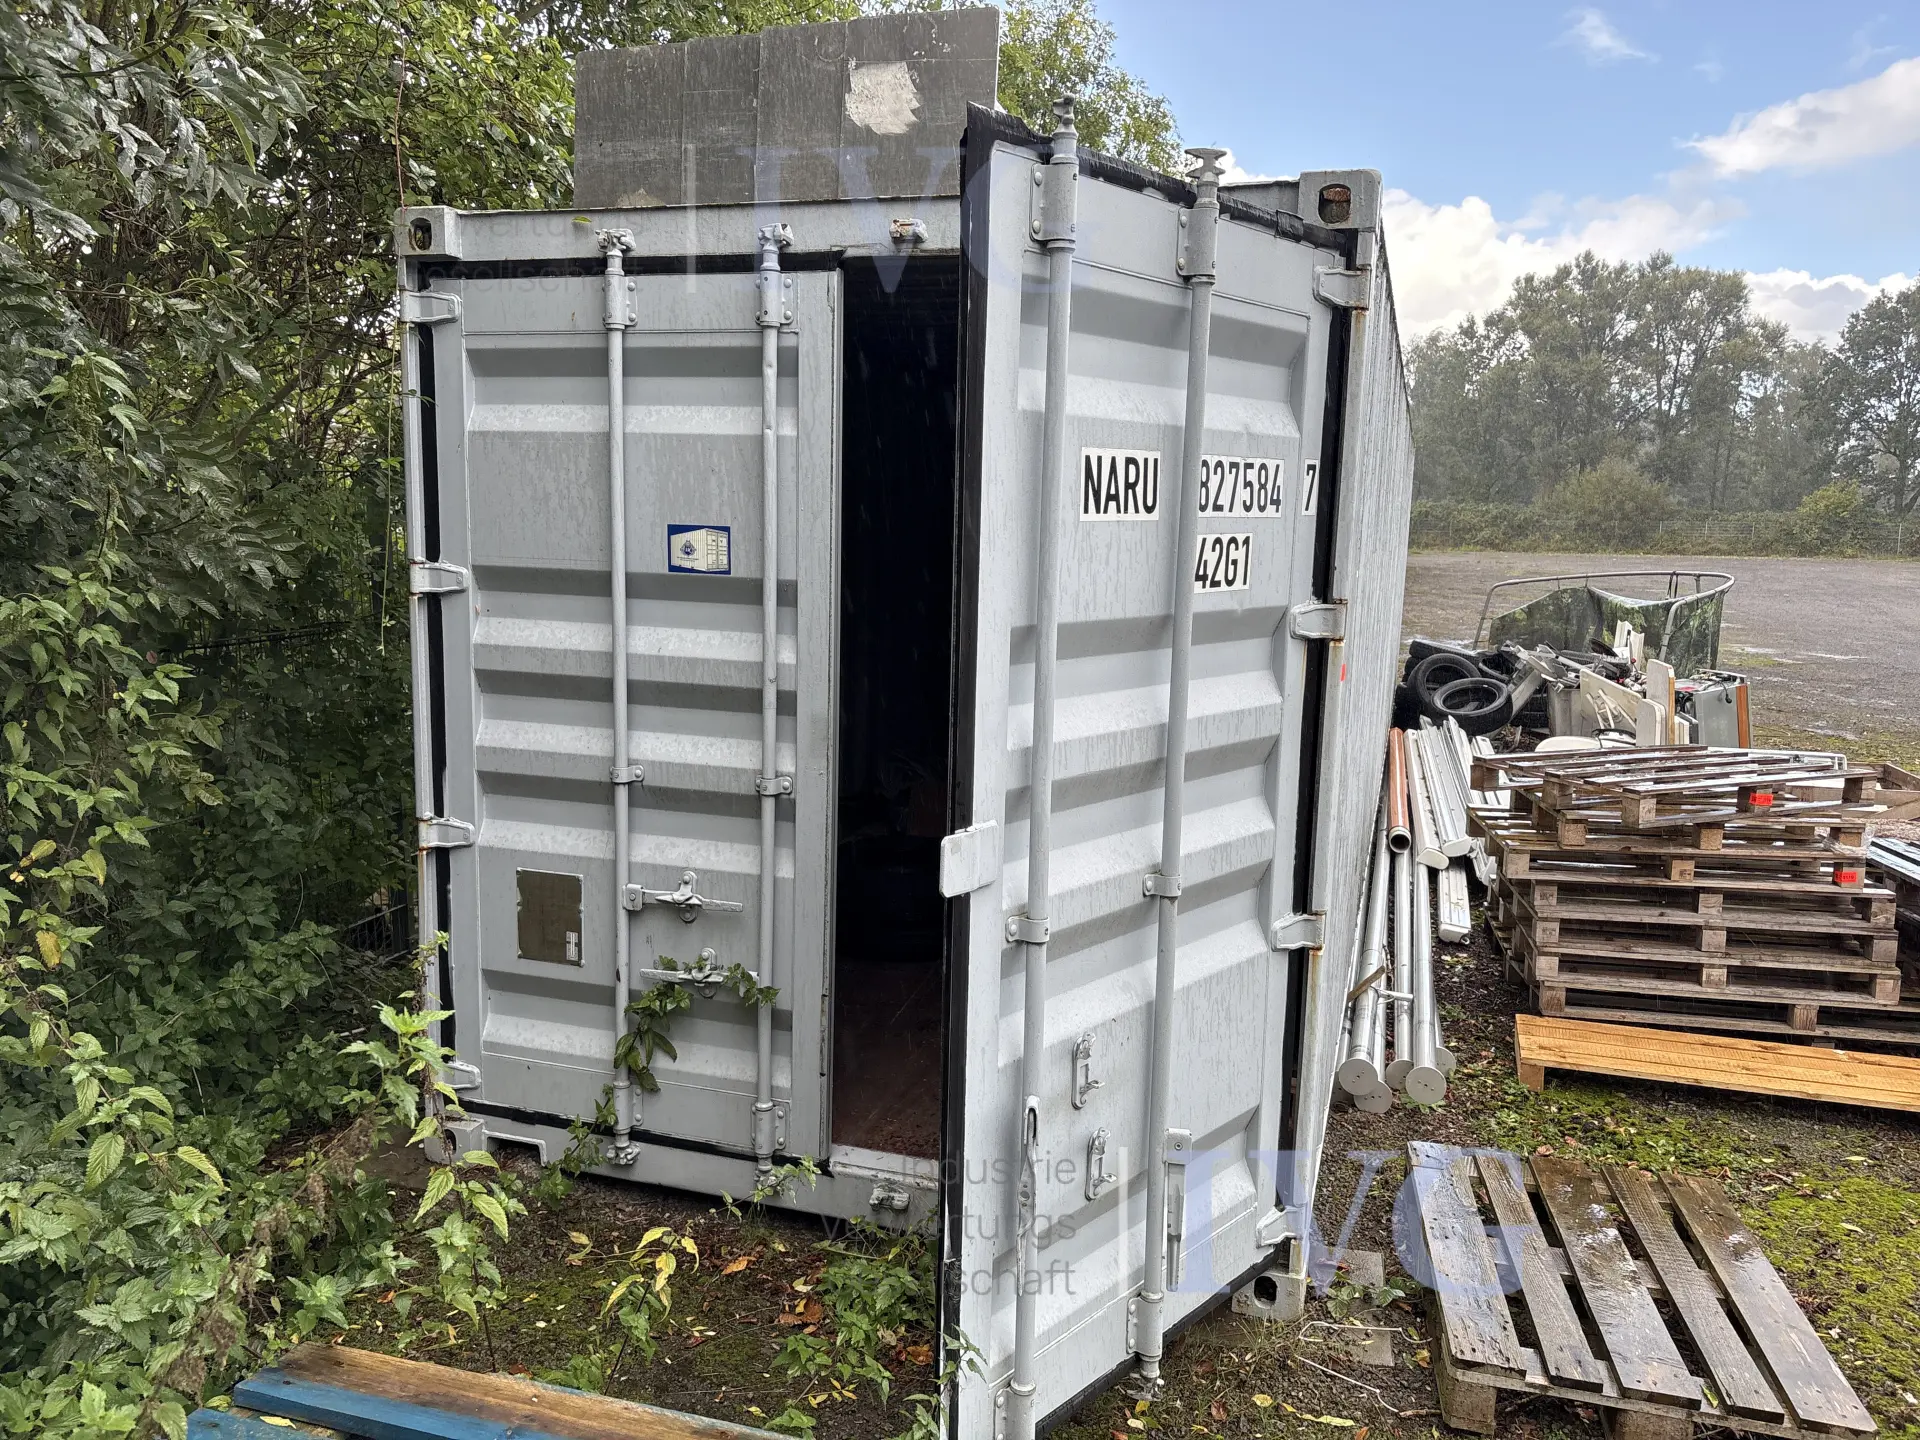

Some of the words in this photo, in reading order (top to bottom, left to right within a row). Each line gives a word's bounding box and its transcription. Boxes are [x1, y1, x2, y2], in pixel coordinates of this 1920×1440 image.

[1083, 454, 1159, 515] NARU
[1198, 459, 1282, 513] 827584
[1305, 463, 1317, 512] 7
[1194, 535, 1251, 589] 42G1
